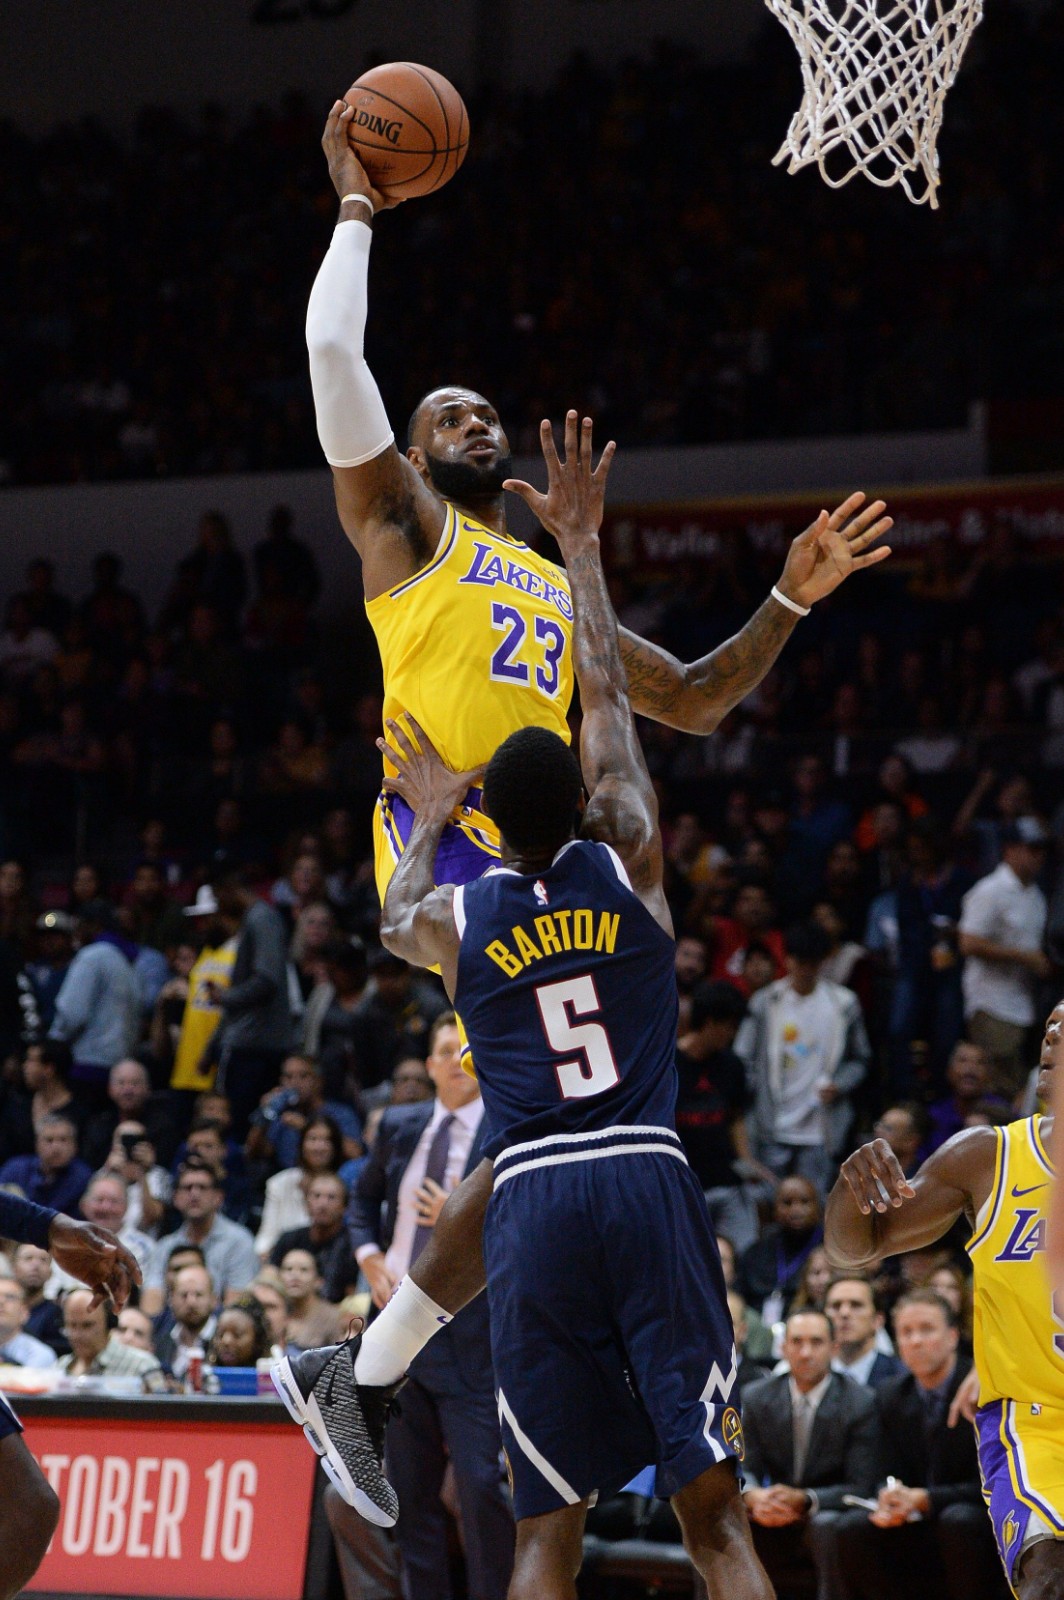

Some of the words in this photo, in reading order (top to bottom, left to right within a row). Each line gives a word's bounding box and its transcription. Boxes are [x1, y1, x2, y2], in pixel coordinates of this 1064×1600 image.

[350, 108, 403, 144] LDING
[457, 541, 574, 622] LAKERS
[490, 600, 565, 700] 23
[484, 908, 621, 979] BARTON
[534, 972, 621, 1099] 5
[41, 1454, 190, 1559] TOBER
[200, 1459, 258, 1563] 16
